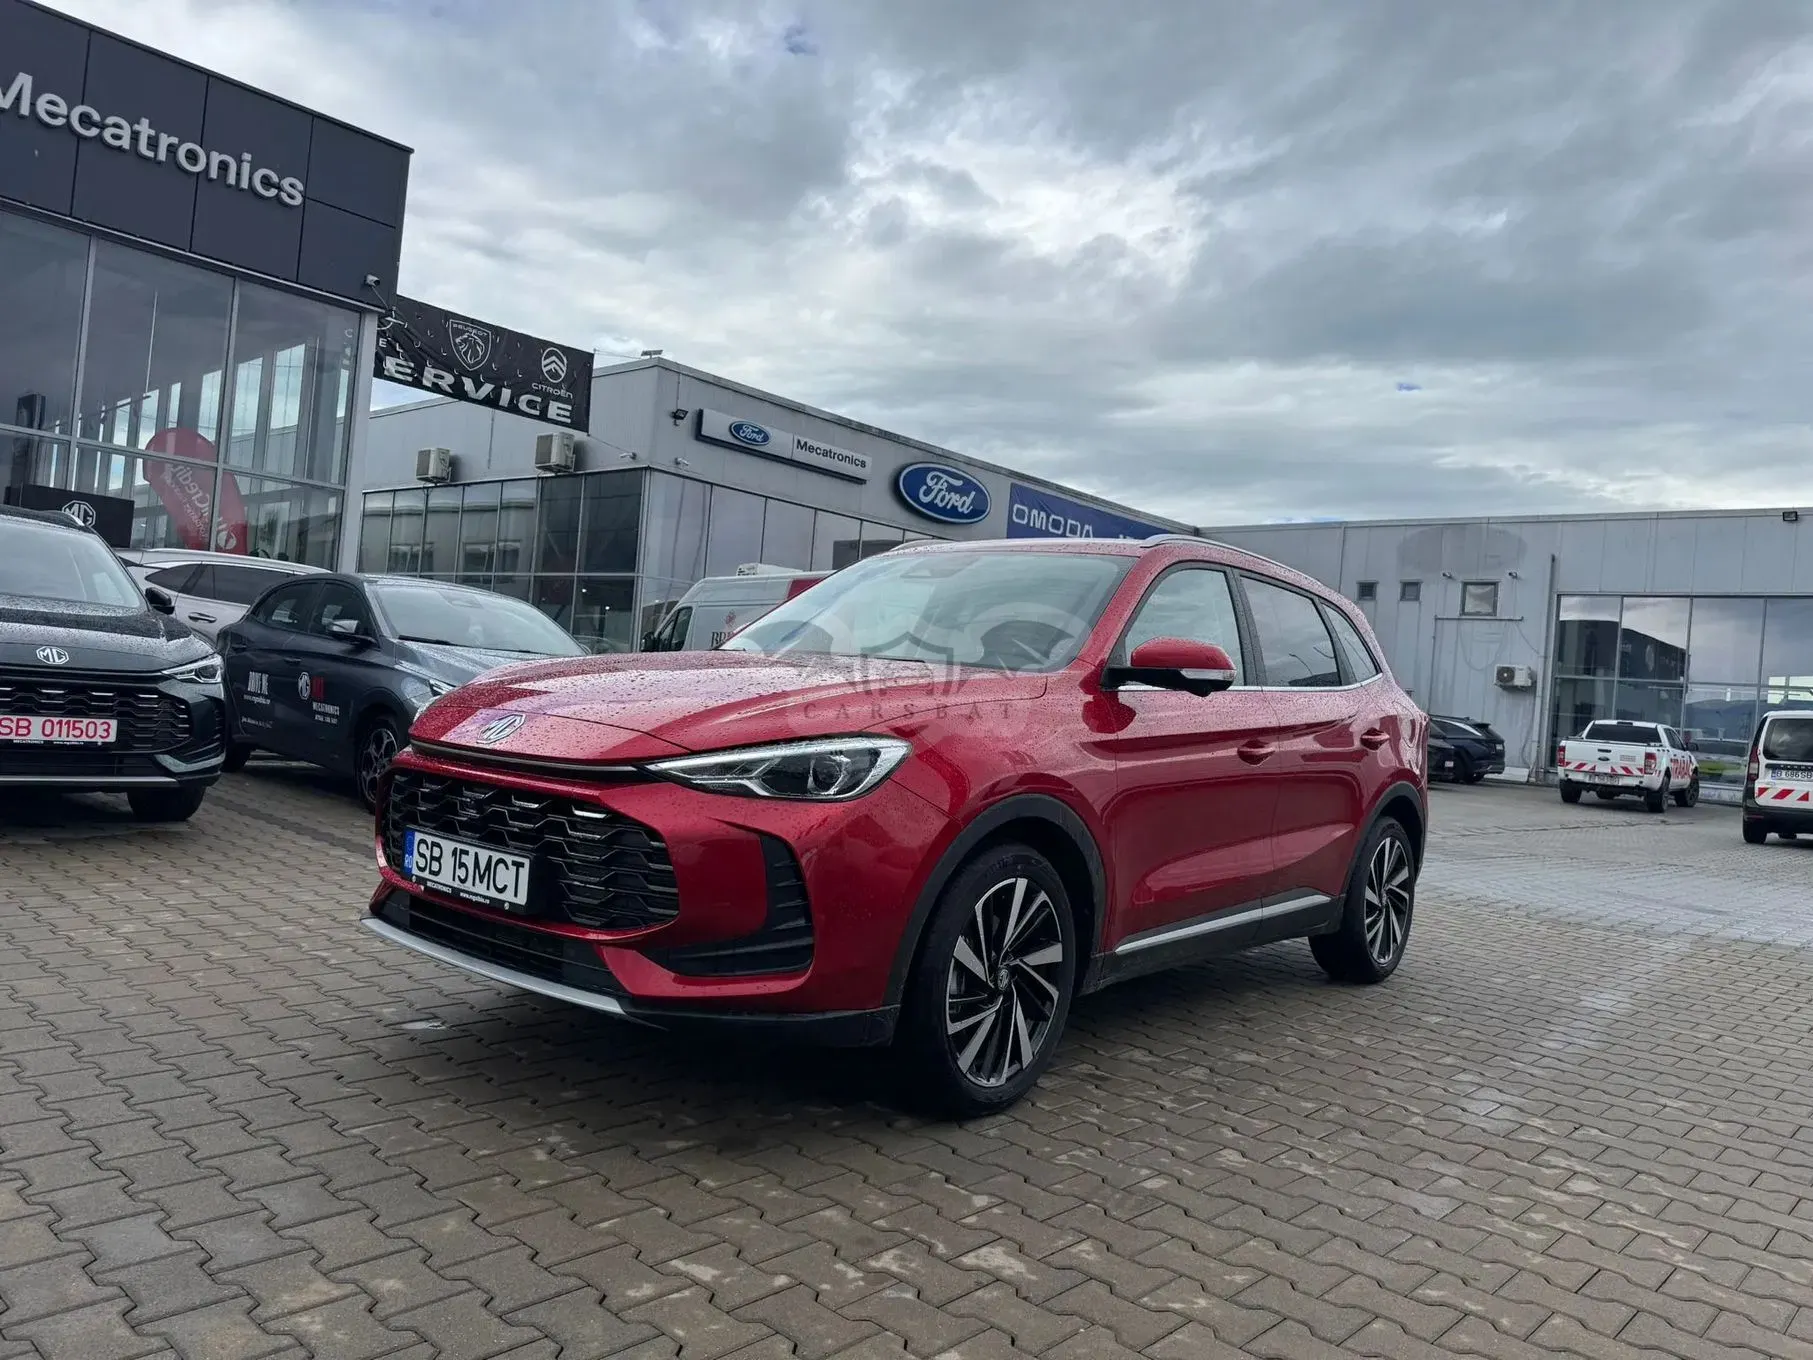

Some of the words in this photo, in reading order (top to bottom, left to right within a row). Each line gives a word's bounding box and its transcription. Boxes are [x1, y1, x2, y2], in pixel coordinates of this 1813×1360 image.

[0, 72, 304, 206] Mecatronics
[384, 356, 572, 424] ERVICE
[739, 424, 764, 442] Ford
[796, 438, 867, 469] Mecatronics
[918, 470, 976, 515] Ford
[1012, 503, 1094, 539] OMODA
[37, 646, 68, 664] MG
[0, 717, 32, 737] SB
[41, 719, 111, 739] 011503
[478, 713, 525, 743] MG
[415, 838, 443, 877] SB
